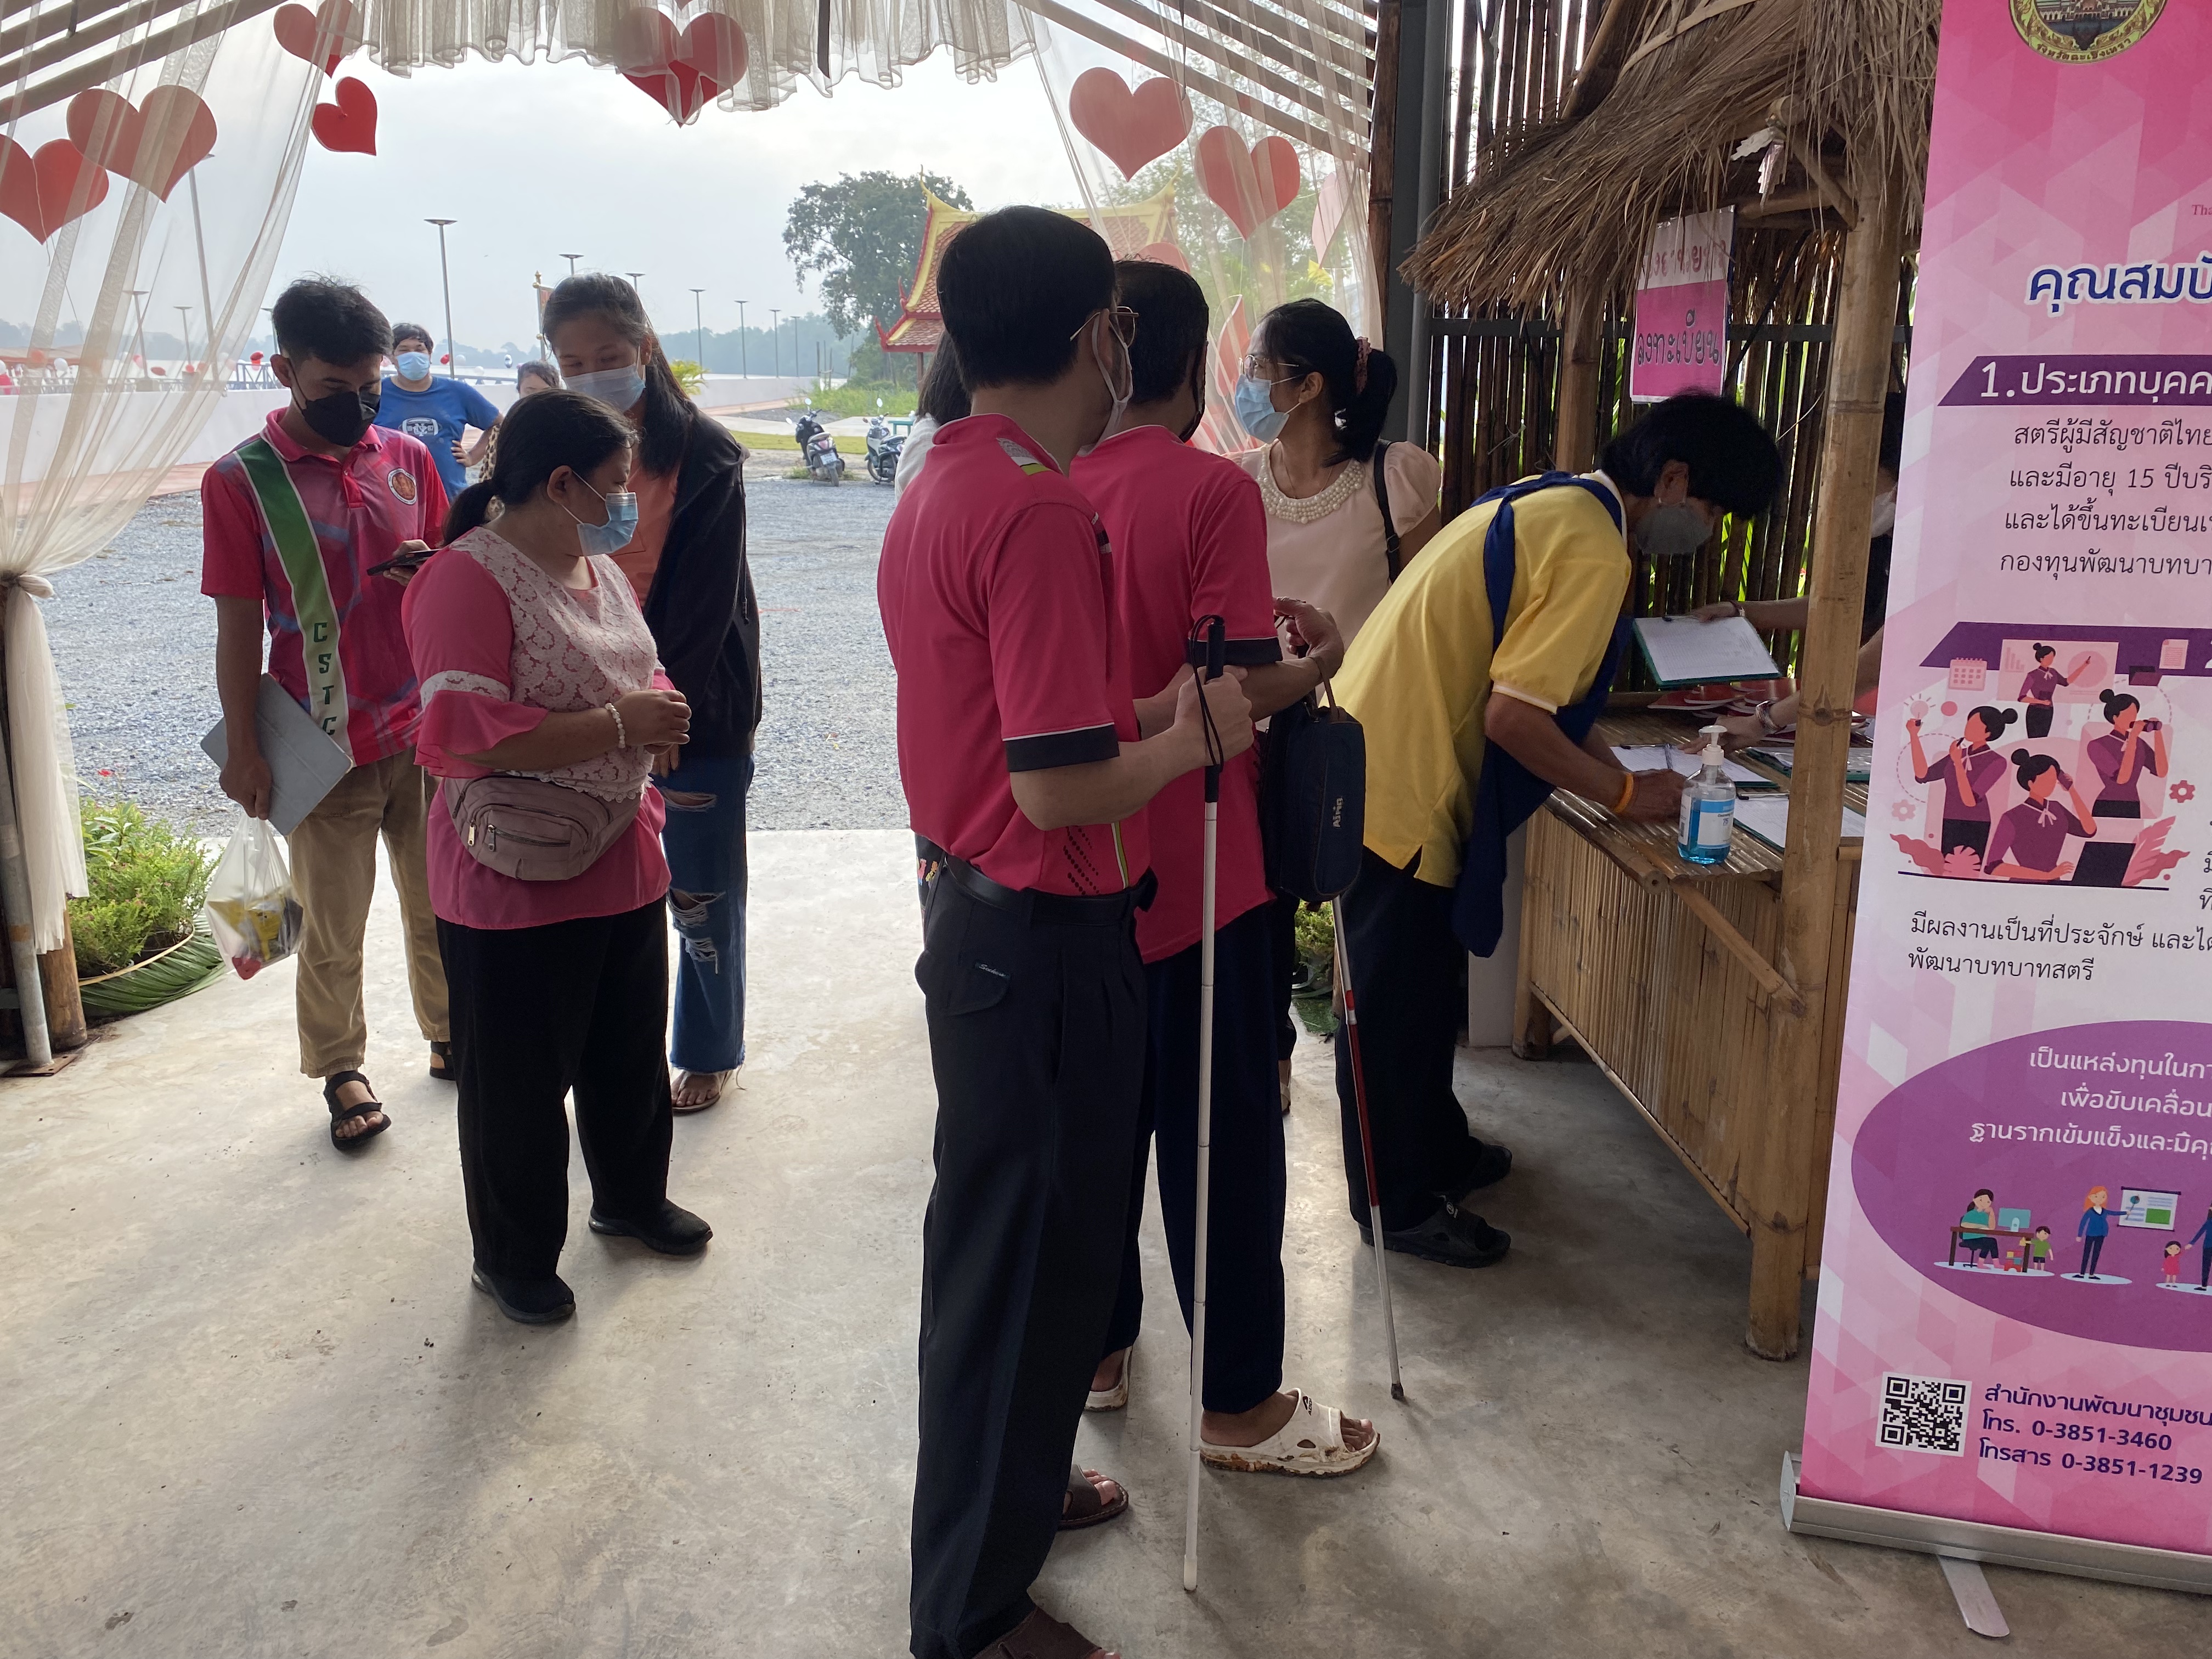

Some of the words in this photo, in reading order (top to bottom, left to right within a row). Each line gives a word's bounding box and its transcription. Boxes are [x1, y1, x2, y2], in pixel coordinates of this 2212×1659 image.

[2010, 461, 2115, 496] และมีอายุ
[2128, 468, 2154, 489] 15
[2005, 497, 2212, 532] และได้ขึ้นทะเบียนเ
[1908, 946, 2095, 980] พัฒนาบทบาทสตรี
[1970, 1122, 2212, 1160] ฐานรากเข้มแข็งและมีคุ
[1982, 1408, 2021, 1434] โทร.
[2032, 1419, 2172, 1451] 0-3851-3460
[1978, 1437, 2052, 1467] โทรสาร
[2062, 1453, 2203, 1484] 0-3851-1239
